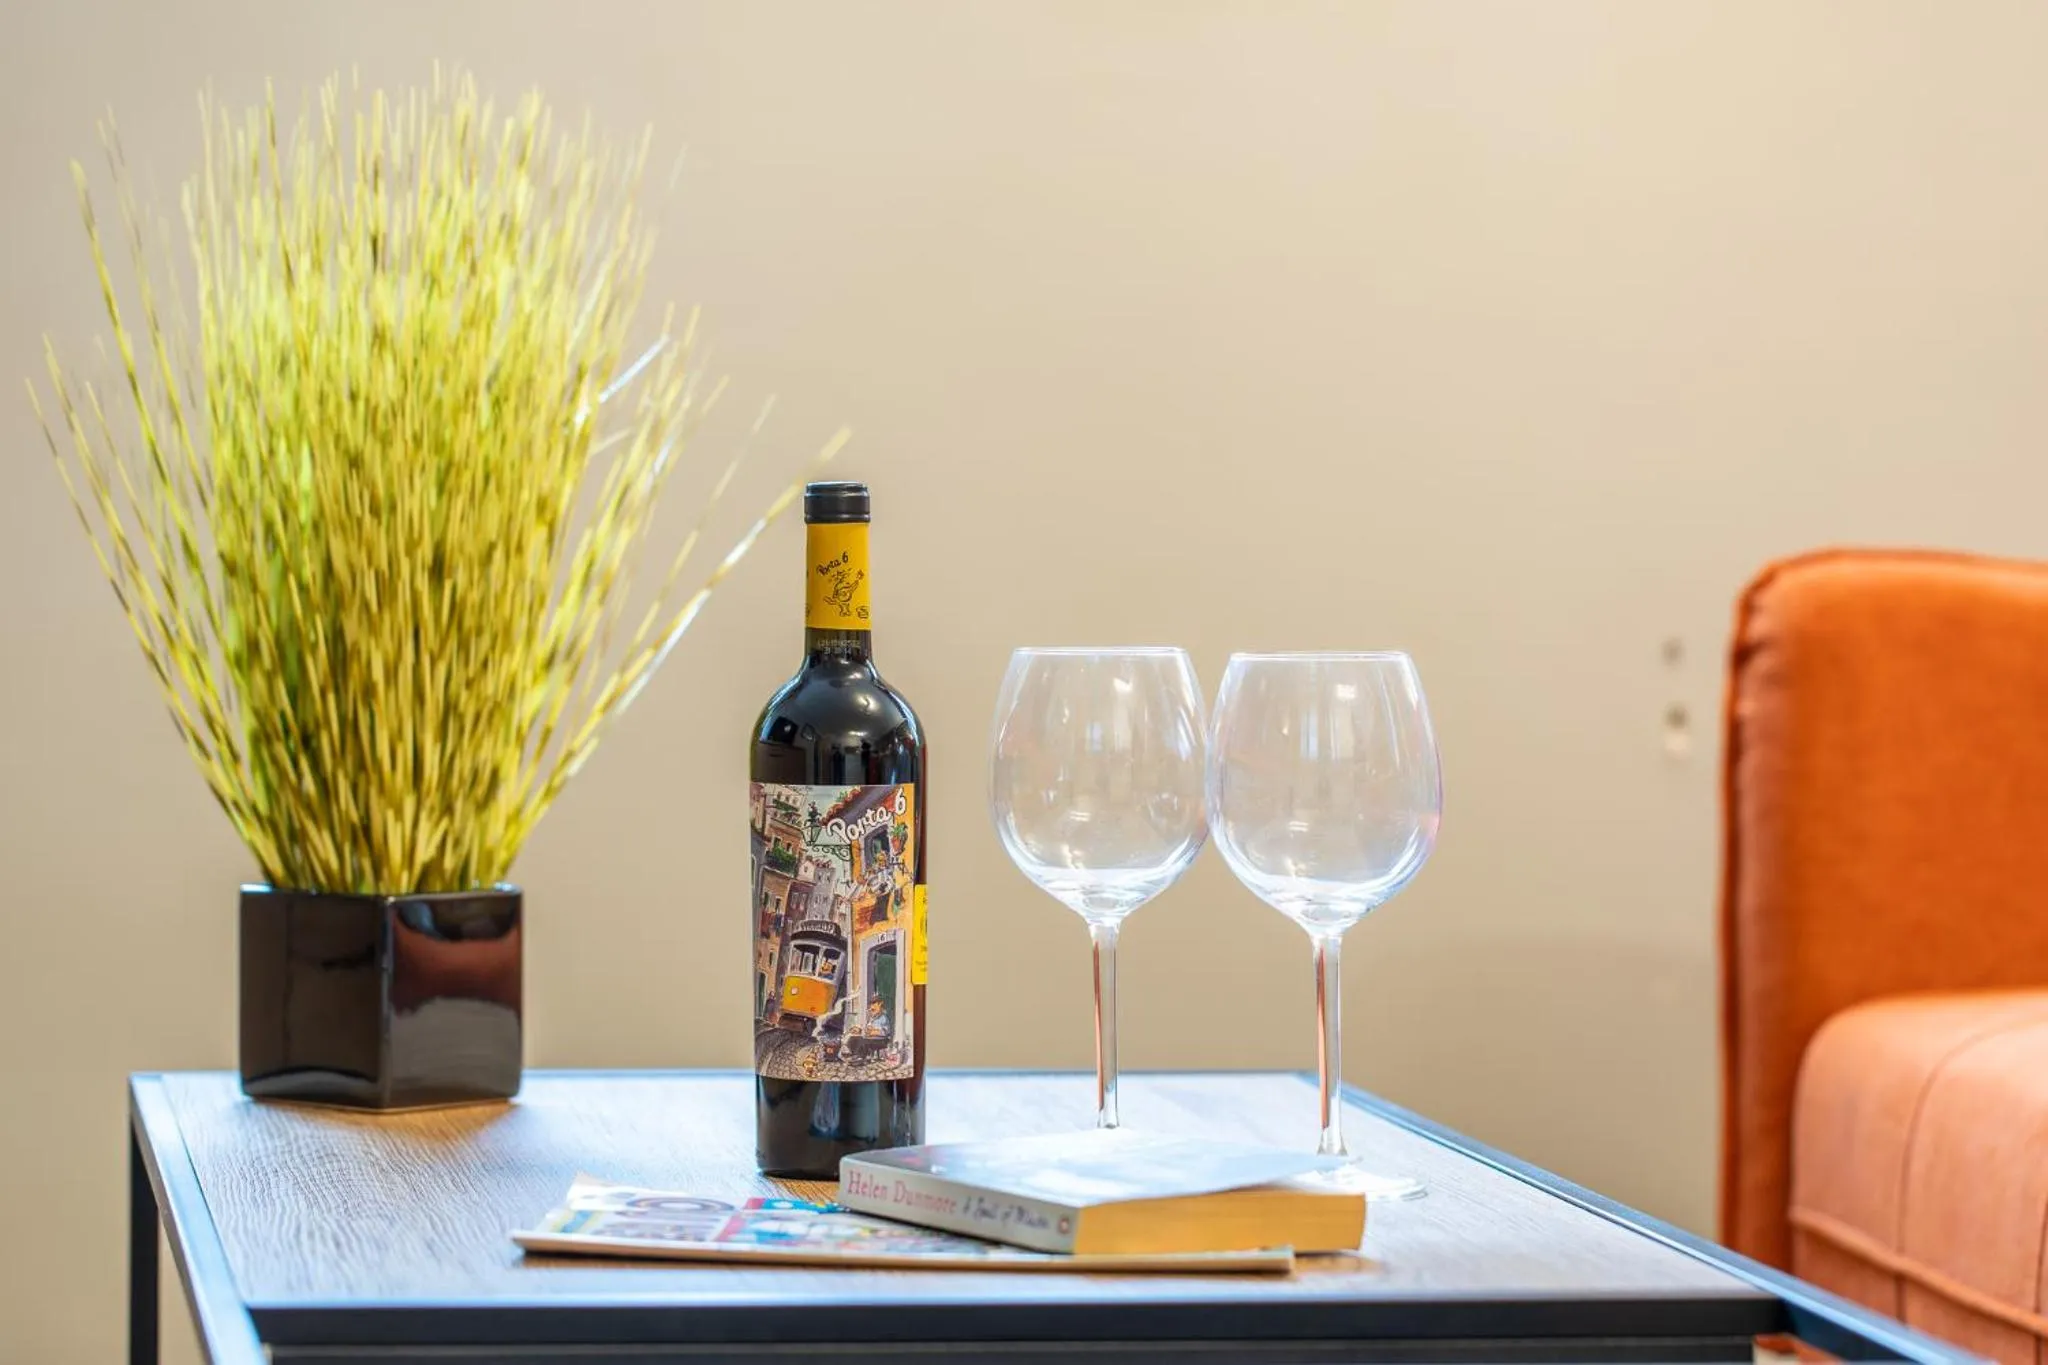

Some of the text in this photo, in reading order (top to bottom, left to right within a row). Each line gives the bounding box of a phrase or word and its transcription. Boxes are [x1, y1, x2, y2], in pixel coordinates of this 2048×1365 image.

[816, 551, 849, 577] Porta 6
[826, 787, 906, 845] Porta 6
[847, 1170, 957, 1214] Helen Dunmore
